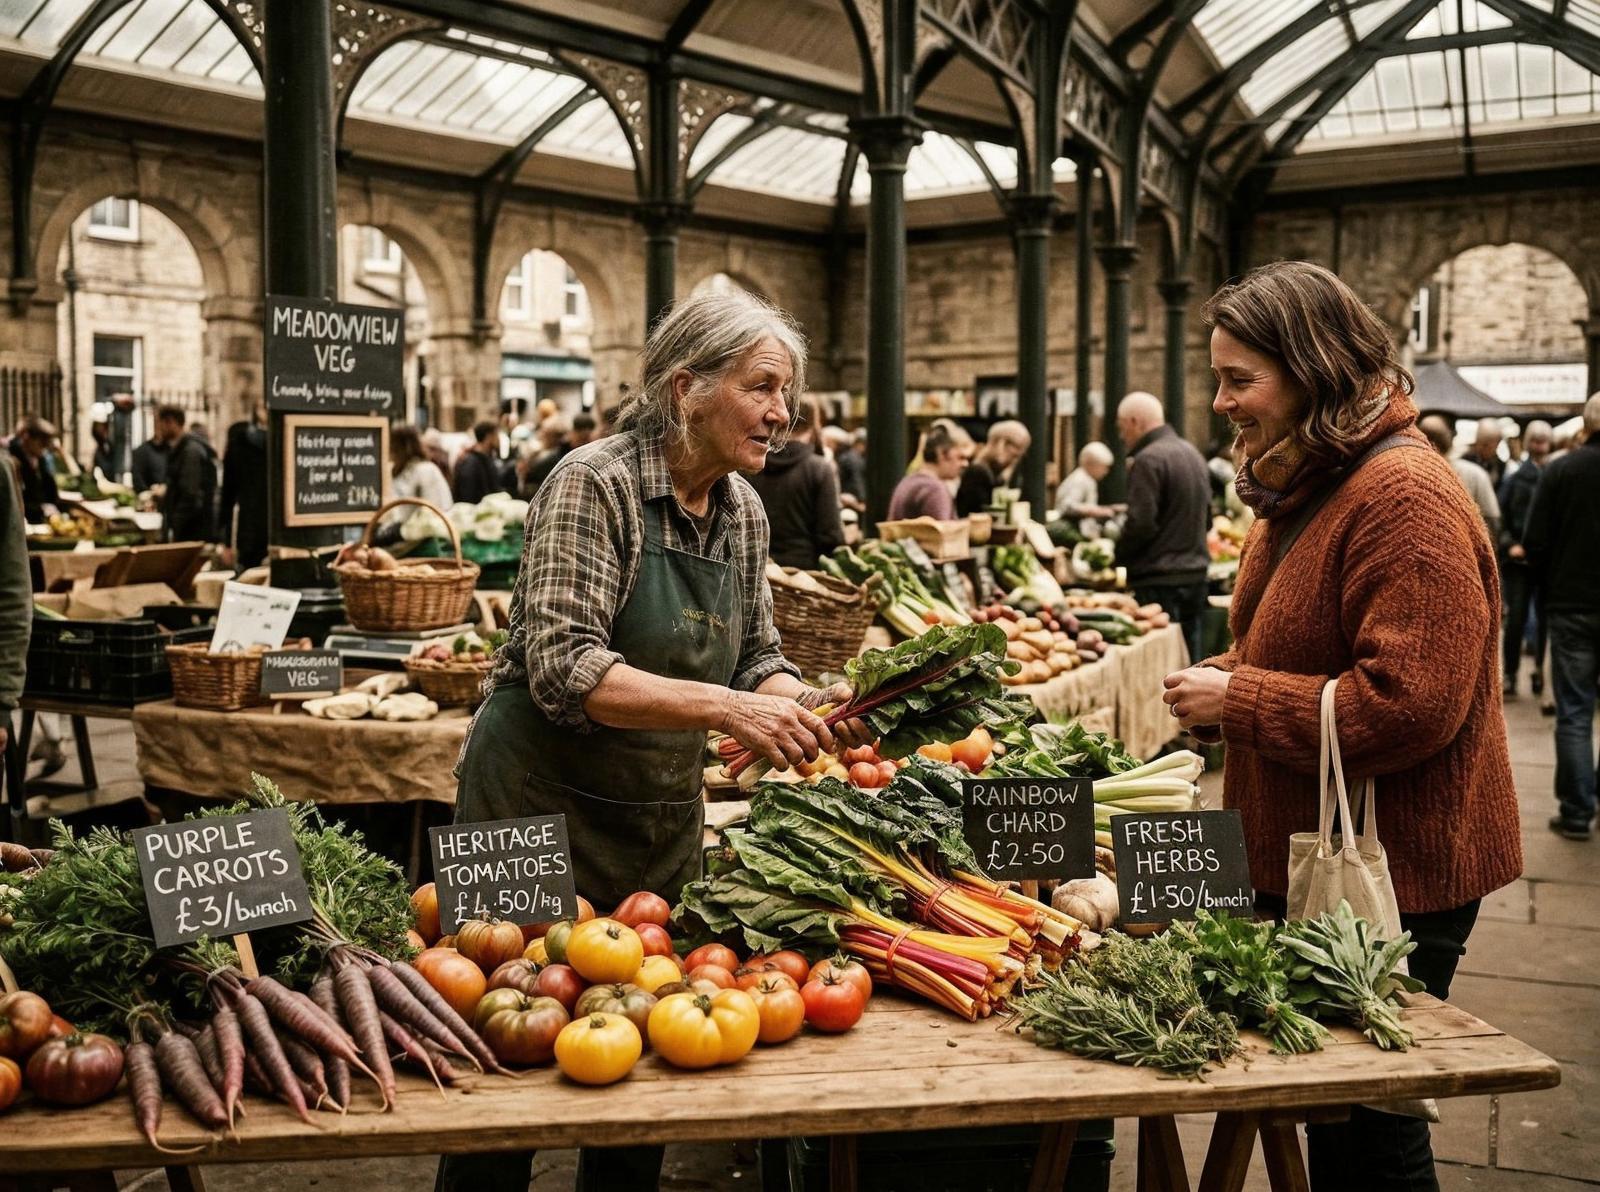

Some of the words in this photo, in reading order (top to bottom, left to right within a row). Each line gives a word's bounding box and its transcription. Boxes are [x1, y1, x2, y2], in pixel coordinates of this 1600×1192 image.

[273, 306, 399, 345] MEADOWVIEW
[314, 344, 356, 373] VEG
[972, 784, 1079, 806] RAINBOW
[986, 811, 1066, 833] CHARD
[1124, 819, 1204, 846] FRESH
[145, 821, 256, 862] PURPLE
[438, 823, 557, 860] HERITAGE
[153, 848, 289, 895] CARROTS
[439, 852, 567, 887] TOMATOES
[1136, 848, 1220, 875] HERBS
[175, 891, 297, 934] £3/bunch
